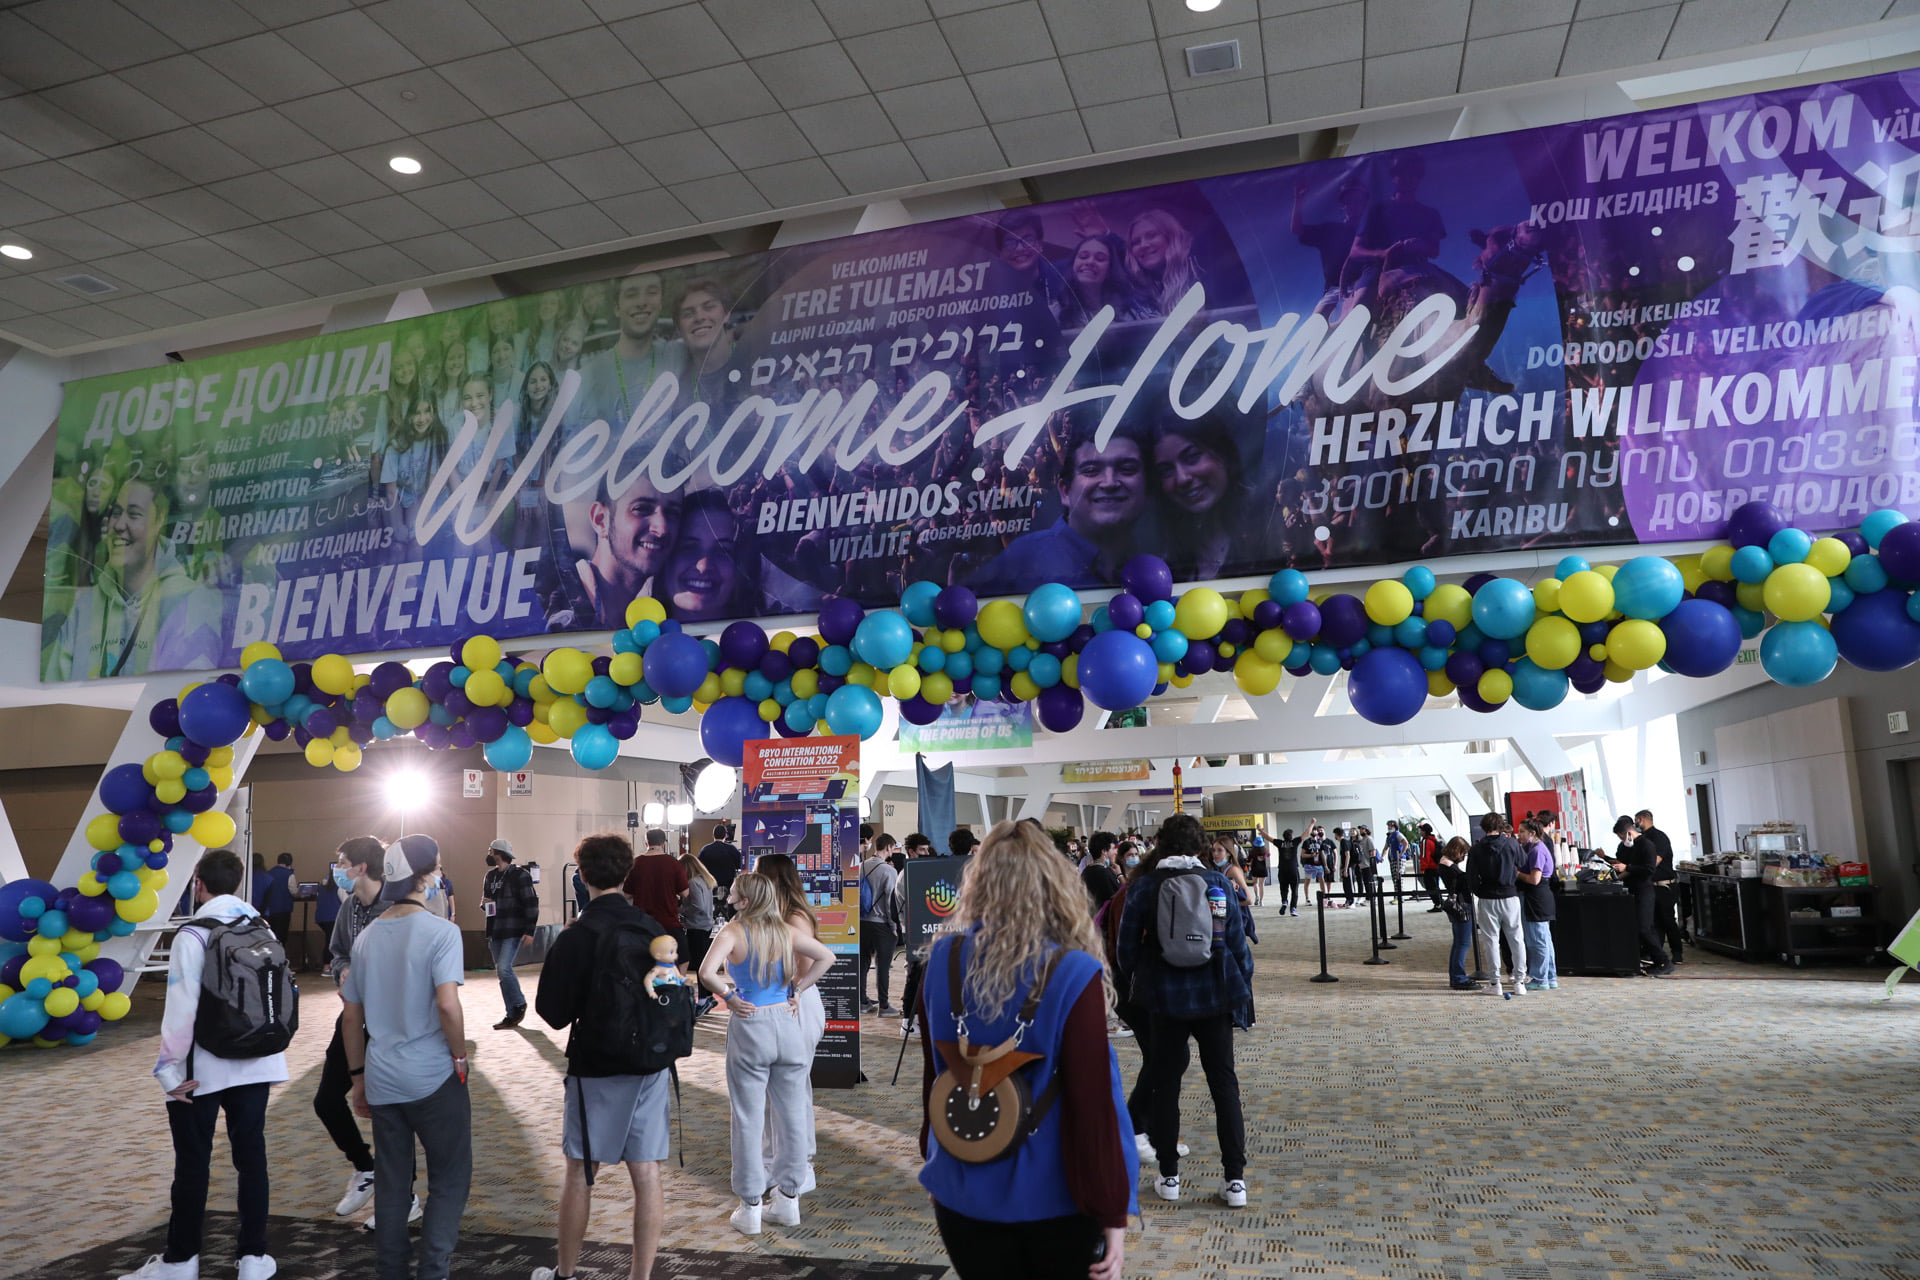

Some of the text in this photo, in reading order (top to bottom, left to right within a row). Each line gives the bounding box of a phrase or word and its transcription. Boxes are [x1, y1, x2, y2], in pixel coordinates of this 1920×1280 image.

[1583, 95, 1855, 183] WELKOM
[832, 249, 928, 280] VELKOMMEN
[780, 262, 991, 321] TERE TULEMAST
[887, 290, 1034, 328] ДОБРО ПОЖАЛОВАТЬ
[770, 315, 875, 345] LAIPNI LŪDZAM
[1589, 298, 1721, 328] XUSH KELIBSIZ
[750, 320, 1024, 386] ברוכים הבאים
[1527, 309, 1900, 370] DOBRODOŠLI VELKOMMEN
[83, 341, 392, 449] ДОБРЕ ДОШЛА
[1309, 356, 1920, 466] HERZLICH WILLKOMME
[414, 284, 1480, 546] Welcome Home
[208, 460, 236, 480] BINE
[172, 506, 309, 545] BEN ARRIVATA
[756, 481, 1034, 535] BIENVENIDOS SVEIKI
[1451, 503, 1568, 539] KARIBU
[829, 530, 912, 563] VITAJTE
[232, 547, 542, 649] BIENVENUE
[1738, 649, 1757, 663] EXIT
[919, 724, 1013, 741] THE POWER OF US
[759, 745, 843, 758] BBYO INTERNATIONAL
[764, 755, 838, 768] CONVENTION 2022
[884, 804, 895, 818] 337
